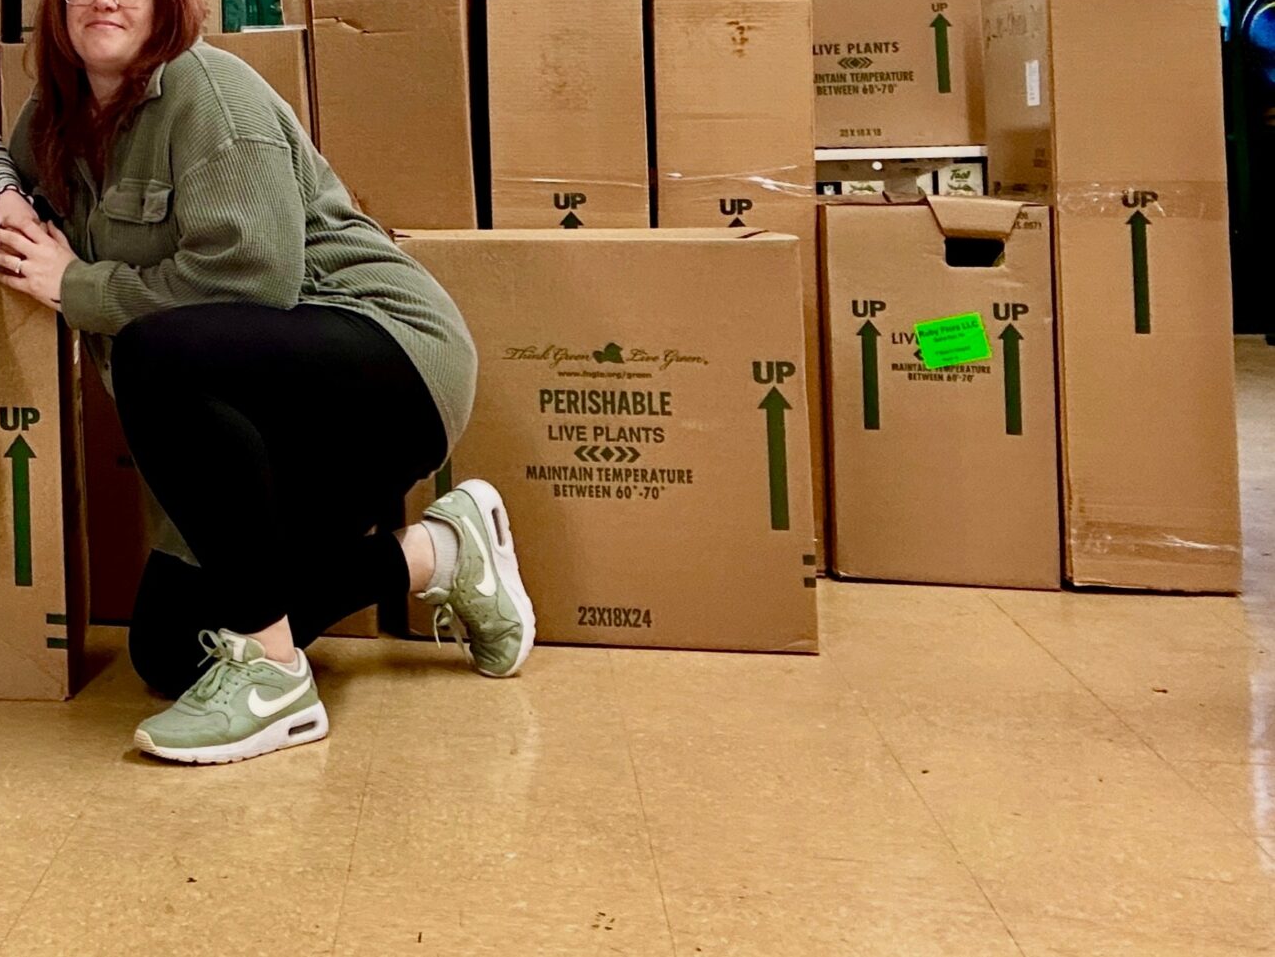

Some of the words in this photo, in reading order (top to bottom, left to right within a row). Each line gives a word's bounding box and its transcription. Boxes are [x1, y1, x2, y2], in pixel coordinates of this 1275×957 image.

[931, 3, 948, 13] UP
[812, 44, 840, 56] LIVE
[847, 42, 899, 54] PLANTS
[813, 73, 847, 84] INTAIN
[849, 71, 914, 83] TEMPERATURE
[816, 85, 859, 96] BETWEEN
[553, 192, 587, 210] UP
[720, 198, 753, 216] UP
[1122, 190, 1158, 208] UP
[852, 300, 887, 318] UP
[993, 302, 1029, 321] UP
[891, 333, 919, 345] LIV
[502, 345, 555, 361] Think
[549, 348, 591, 369] Green
[626, 348, 660, 363] Live
[752, 361, 796, 384] UP
[908, 372, 944, 381] BETWEEN
[539, 389, 672, 416] PERISHABLE
[548, 425, 587, 442] LIVE
[593, 426, 665, 443] PLANTS
[525, 466, 593, 481] MAINTAIN
[597, 467, 693, 484] TEMPERATURE
[553, 484, 612, 499] BETWEEN
[578, 606, 652, 628] 23X18X24
